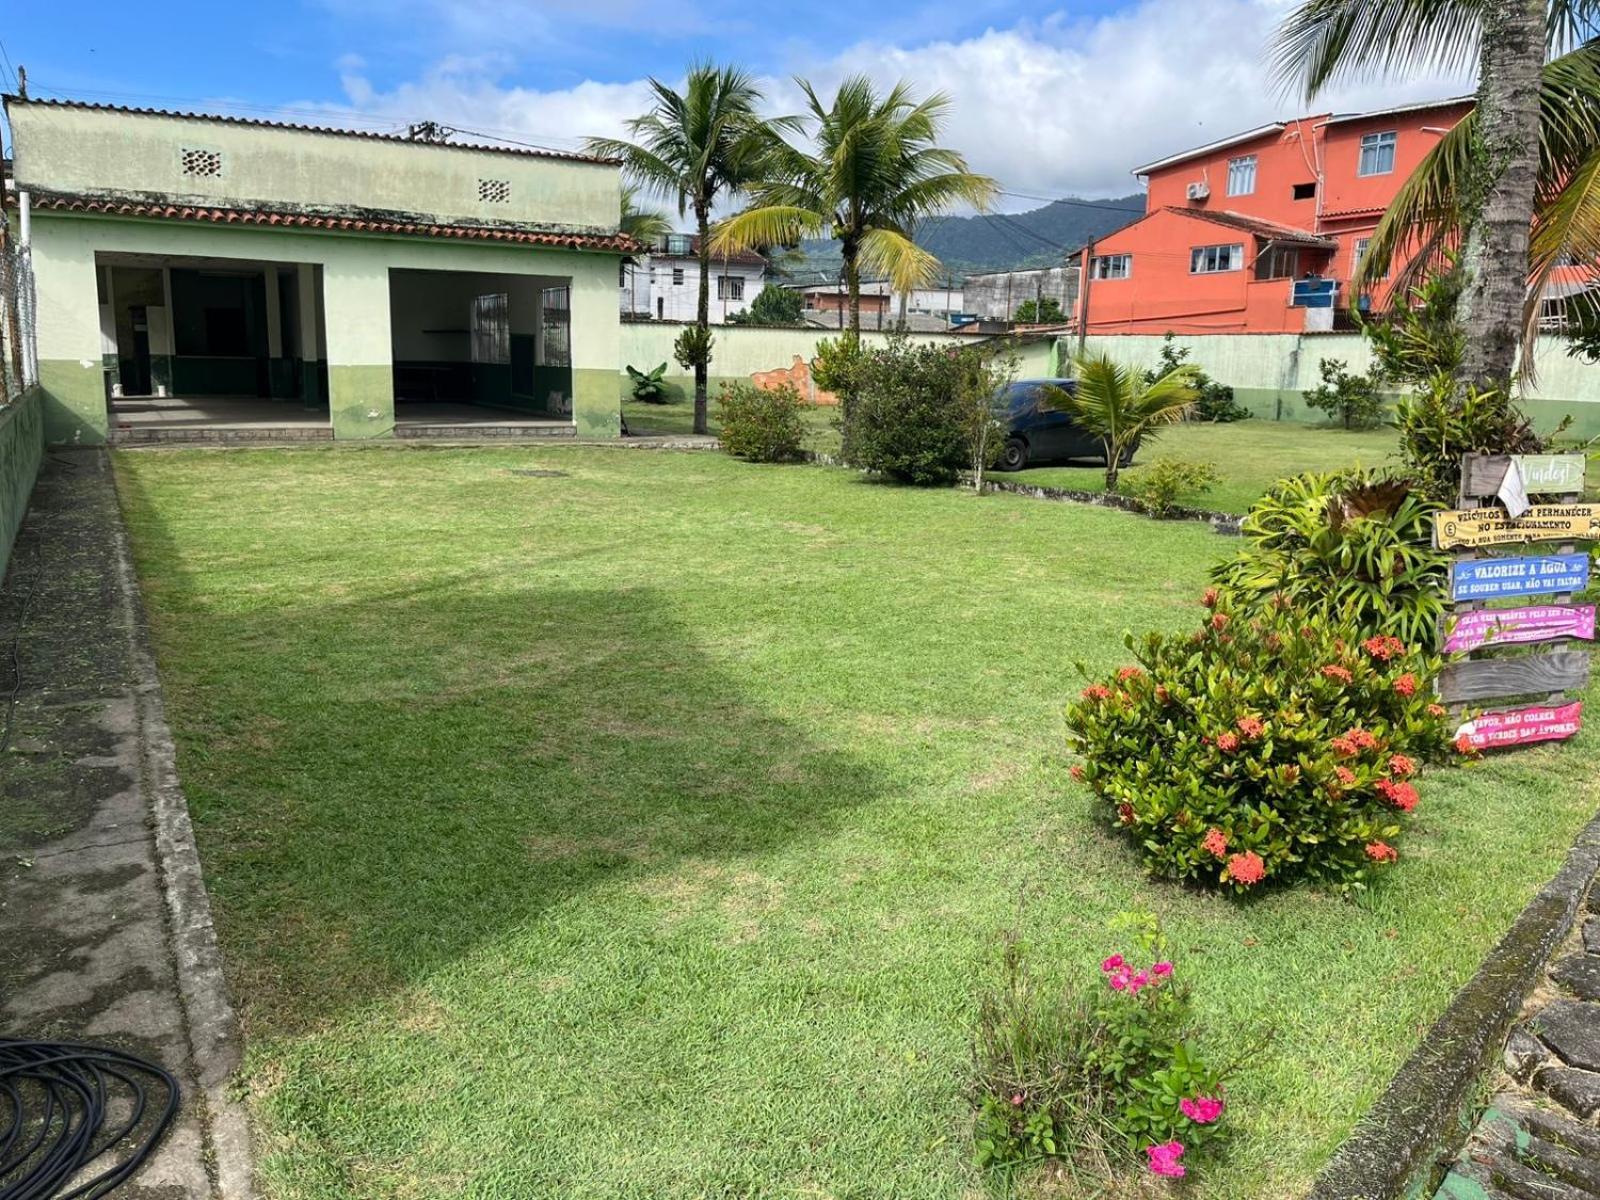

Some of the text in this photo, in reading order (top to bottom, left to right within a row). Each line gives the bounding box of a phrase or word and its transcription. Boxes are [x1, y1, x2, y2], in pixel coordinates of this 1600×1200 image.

[1457, 510, 1500, 523] VEÍCULOS
[1537, 506, 1592, 518] PERMANECER
[1478, 520, 1571, 532] NO ESTACIONAMENTO
[1474, 560, 1567, 579] VALORIZE A ÁGUA
[1458, 585, 1468, 594] SE
[1470, 583, 1499, 593] SOUBER
[1525, 578, 1540, 589] NÃO
[1543, 578, 1554, 588] VAI
[1504, 712, 1521, 725] NÃO
[1524, 712, 1555, 722] COLHER
